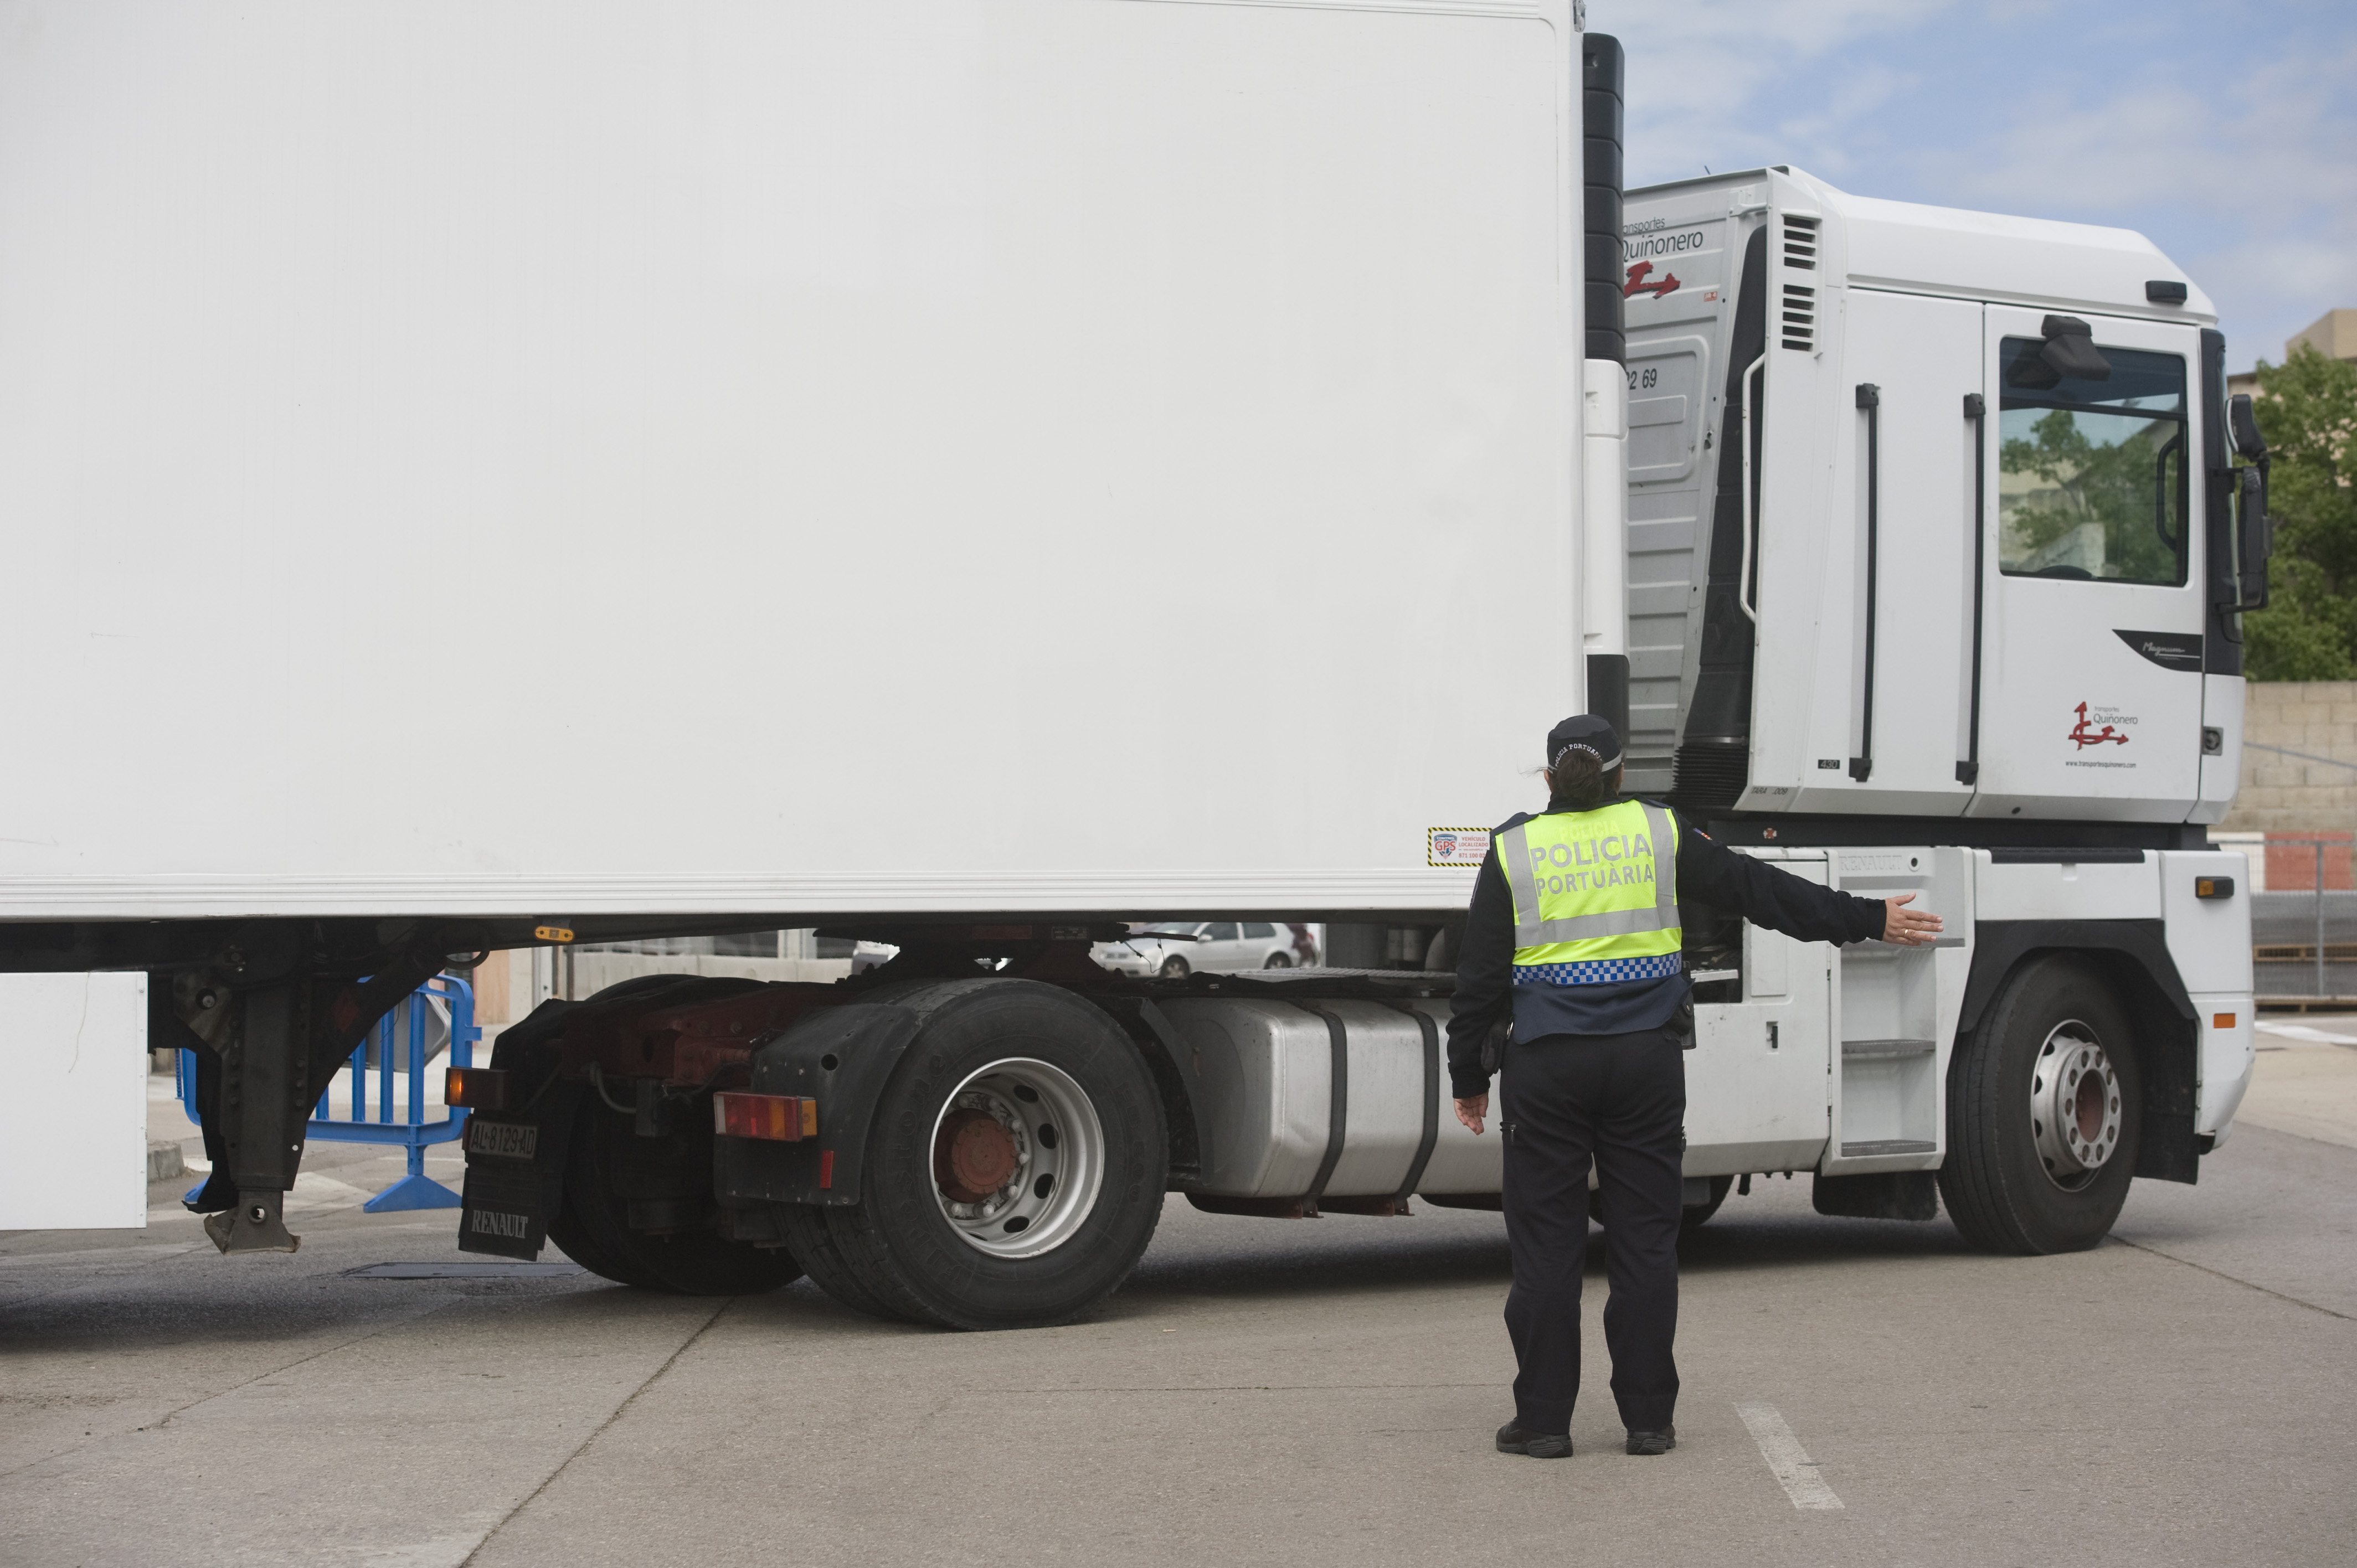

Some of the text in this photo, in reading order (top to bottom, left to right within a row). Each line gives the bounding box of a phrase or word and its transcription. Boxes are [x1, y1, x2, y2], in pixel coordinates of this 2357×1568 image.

[1623, 216, 1665, 235] ansportes
[1642, 368, 1658, 389] 69
[2093, 713, 2138, 725] Quiñonero
[1820, 760, 1838, 768] 430
[1435, 841, 1456, 851] GPS
[1530, 833, 1653, 872] POLICIA
[1839, 855, 1902, 870] RENAULT
[1535, 862, 1655, 897] PORTUÀRIA
[471, 1209, 528, 1239] RENAULT
